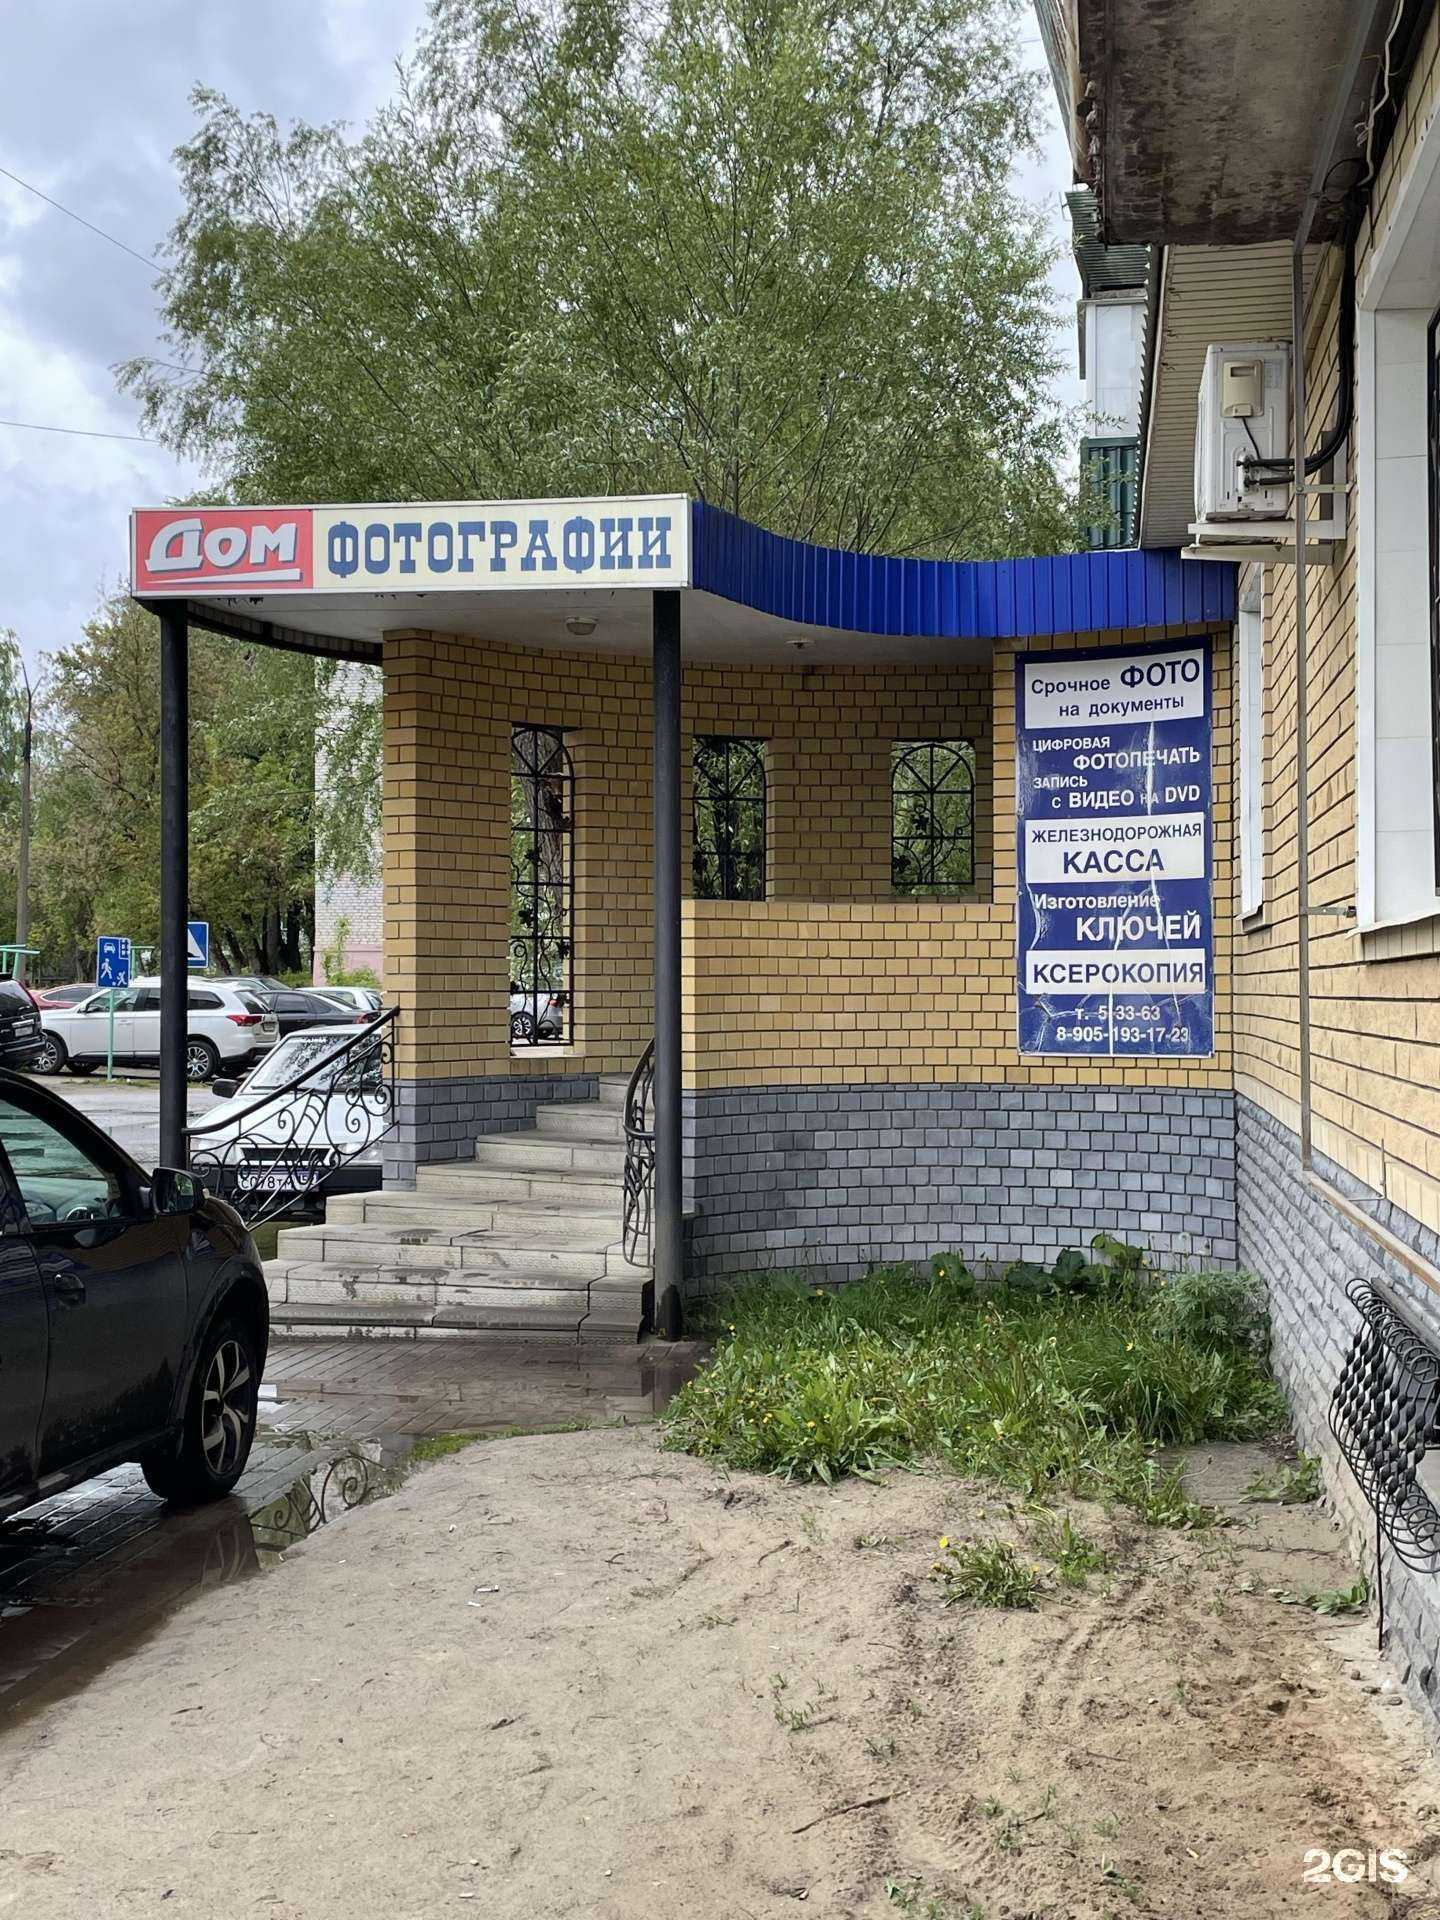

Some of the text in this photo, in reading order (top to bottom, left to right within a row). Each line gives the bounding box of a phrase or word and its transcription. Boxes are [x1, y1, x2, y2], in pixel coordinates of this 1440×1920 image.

[328, 515, 672, 579] ФОТОГРАФИИ
[1031, 658, 1200, 697] Срочное ФОТО
[1059, 696, 1184, 718] на документы
[1032, 736, 1111, 753] ЦИФРОВАЯ
[1073, 746, 1201, 771] ФОТОПЕЧАТЬ
[1033, 775, 1088, 790] ЗАПИСЬ
[1069, 789, 1135, 810] ВИДЕО
[1165, 785, 1200, 804] DVD
[1032, 822, 1202, 844] ЖЕЛЕЗНОДОРОЖНАЯ
[1063, 848, 1165, 875] КАССА
[1034, 893, 1161, 911] Изготовление
[1076, 910, 1201, 942] КЛЮЧЕЙ
[1033, 962, 1204, 984] КСЕРОКОПИЯ
